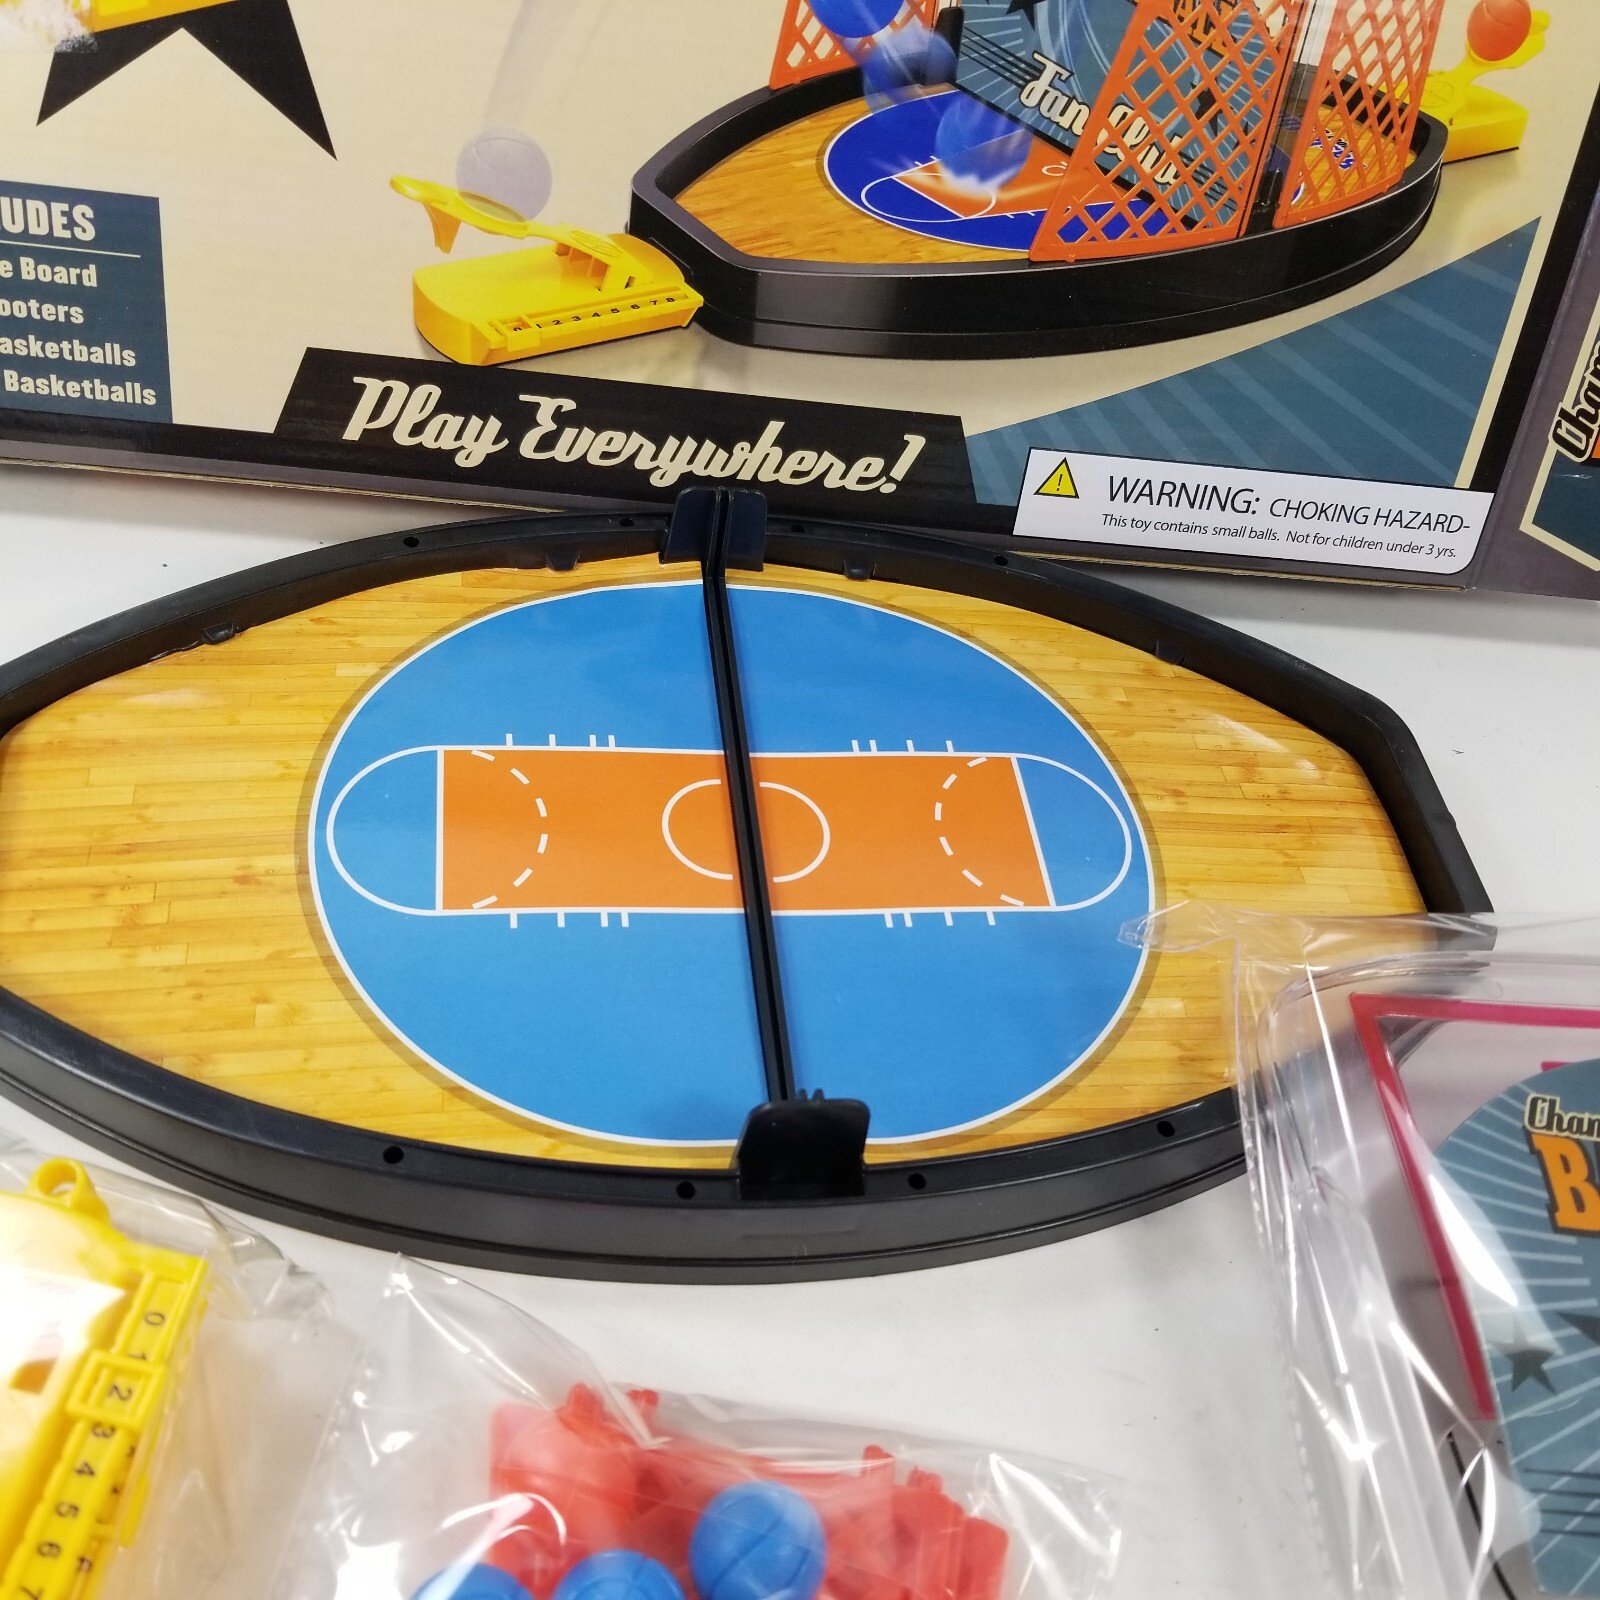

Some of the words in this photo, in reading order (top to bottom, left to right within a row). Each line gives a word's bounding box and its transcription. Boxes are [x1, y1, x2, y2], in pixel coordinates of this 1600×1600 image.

[0, 196, 96, 241] UDES
[20, 256, 97, 287] Board
[3, 369, 156, 405] Basketballs
[341, 376, 508, 468] Play
[518, 394, 926, 494] Everywhere!
[1109, 475, 1261, 515] WARNING:
[1269, 498, 1371, 525] CHOKING
[1373, 507, 1471, 534] HAZARD-
[1102, 513, 1128, 528] This
[1130, 516, 1152, 532] toy
[1153, 521, 1208, 535] contains
[1212, 525, 1247, 538] small
[1248, 527, 1280, 542] balls.
[1286, 530, 1311, 544] Not
[1312, 532, 1331, 547] for
[1332, 534, 1383, 551] children
[1386, 541, 1424, 555] under
[1425, 543, 1435, 555] 3
[1435, 547, 1457, 559] yrs.
[143, 1311, 166, 1328] 0
[108, 1384, 134, 1402] 2
[91, 1422, 116, 1439] 3
[74, 1461, 96, 1477] 4
[55, 1501, 80, 1519] 5
[37, 1540, 62, 1559] 6
